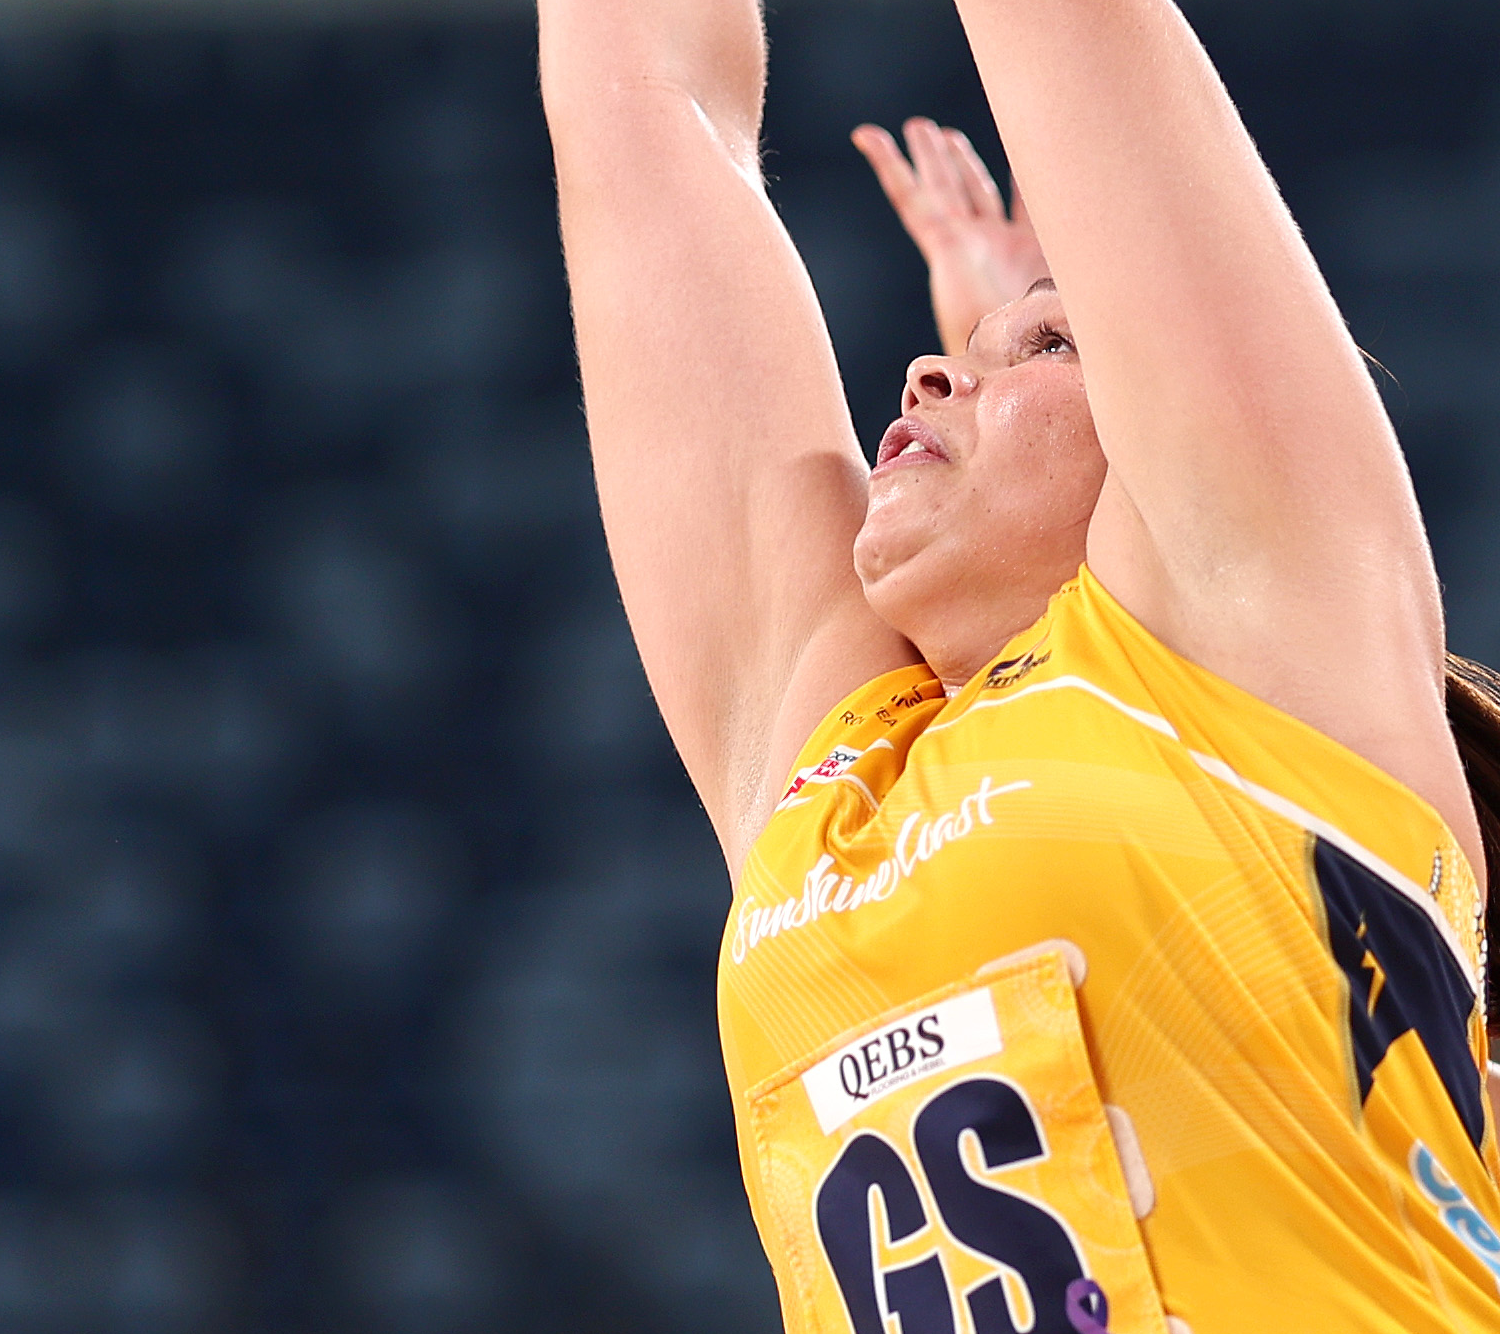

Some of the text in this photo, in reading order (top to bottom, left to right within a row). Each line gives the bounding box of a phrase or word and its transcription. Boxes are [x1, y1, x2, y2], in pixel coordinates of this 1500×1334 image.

[732, 776, 1032, 964] Sunshine Coast
[839, 1013, 945, 1101] QEBS
